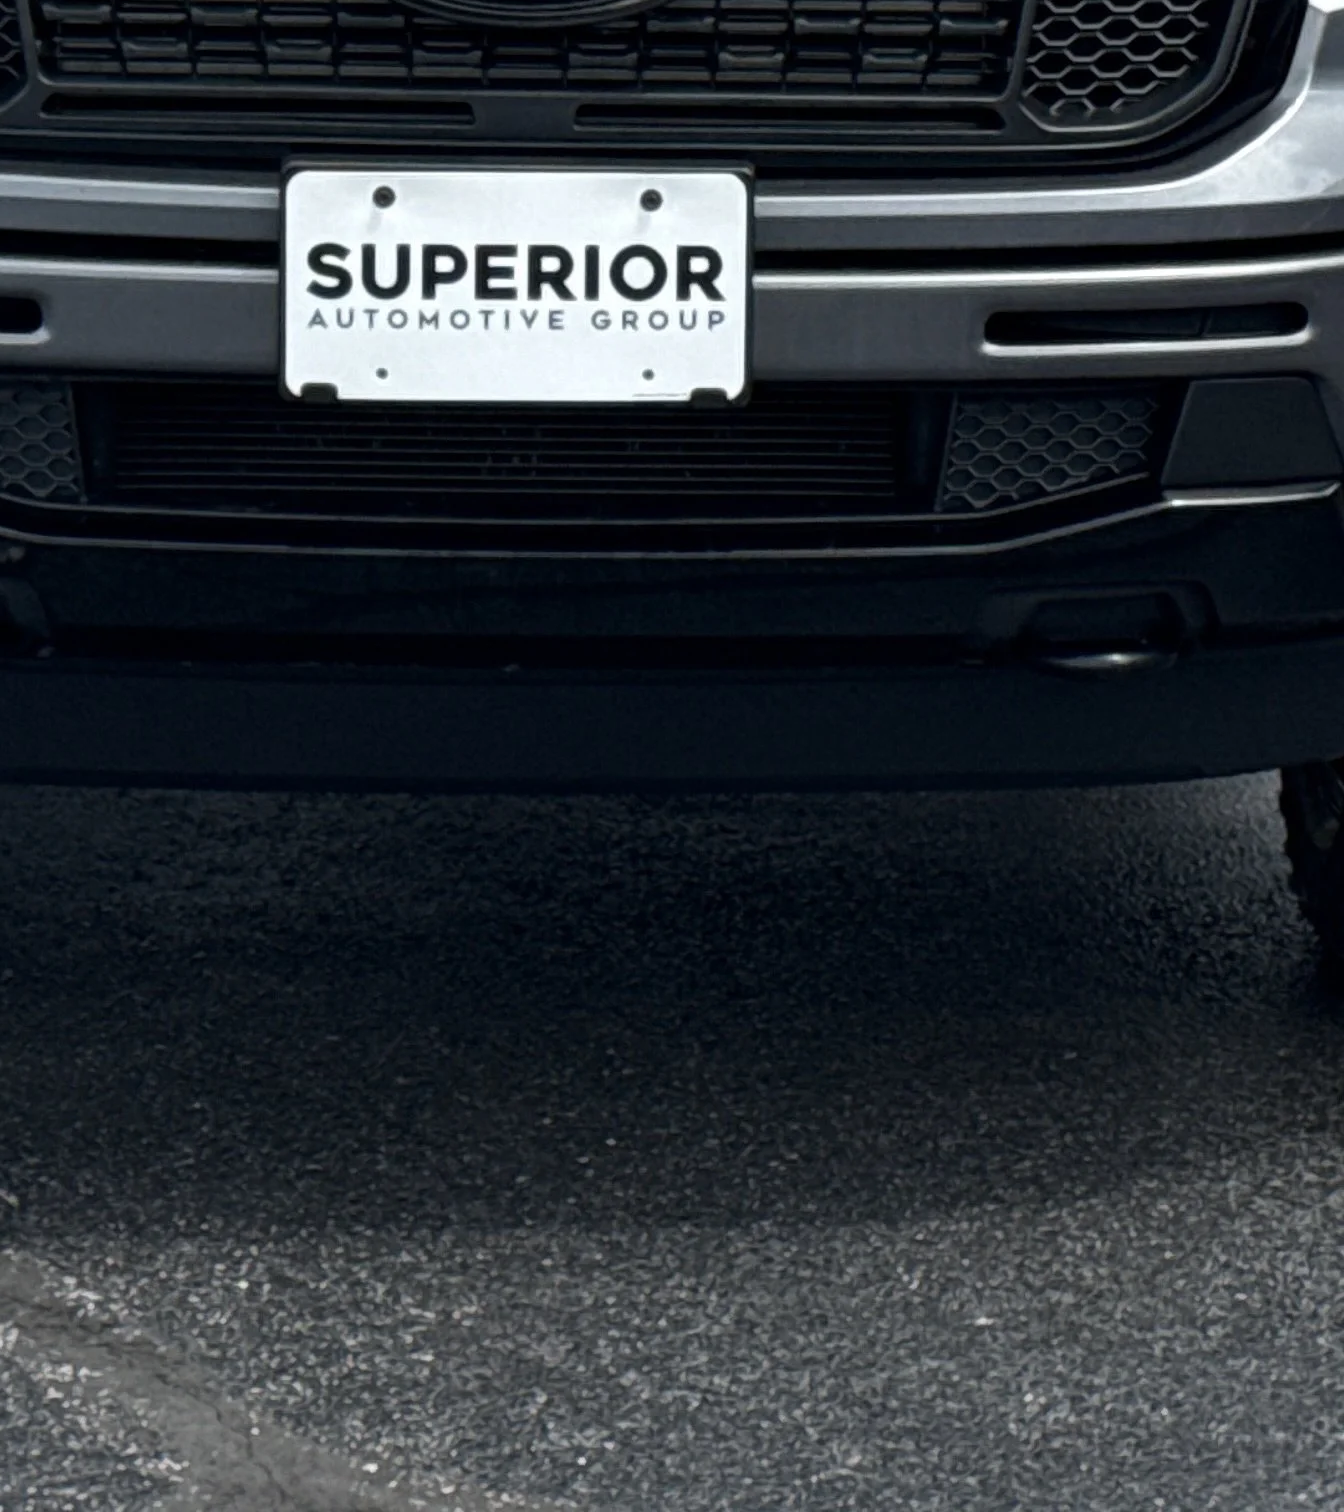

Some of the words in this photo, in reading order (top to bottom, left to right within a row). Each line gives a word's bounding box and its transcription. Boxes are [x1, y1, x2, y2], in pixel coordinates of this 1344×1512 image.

[306, 243, 726, 301] SUPERIOR
[307, 309, 566, 330] AUTOMOTIVE
[591, 309, 727, 331] GROUP
